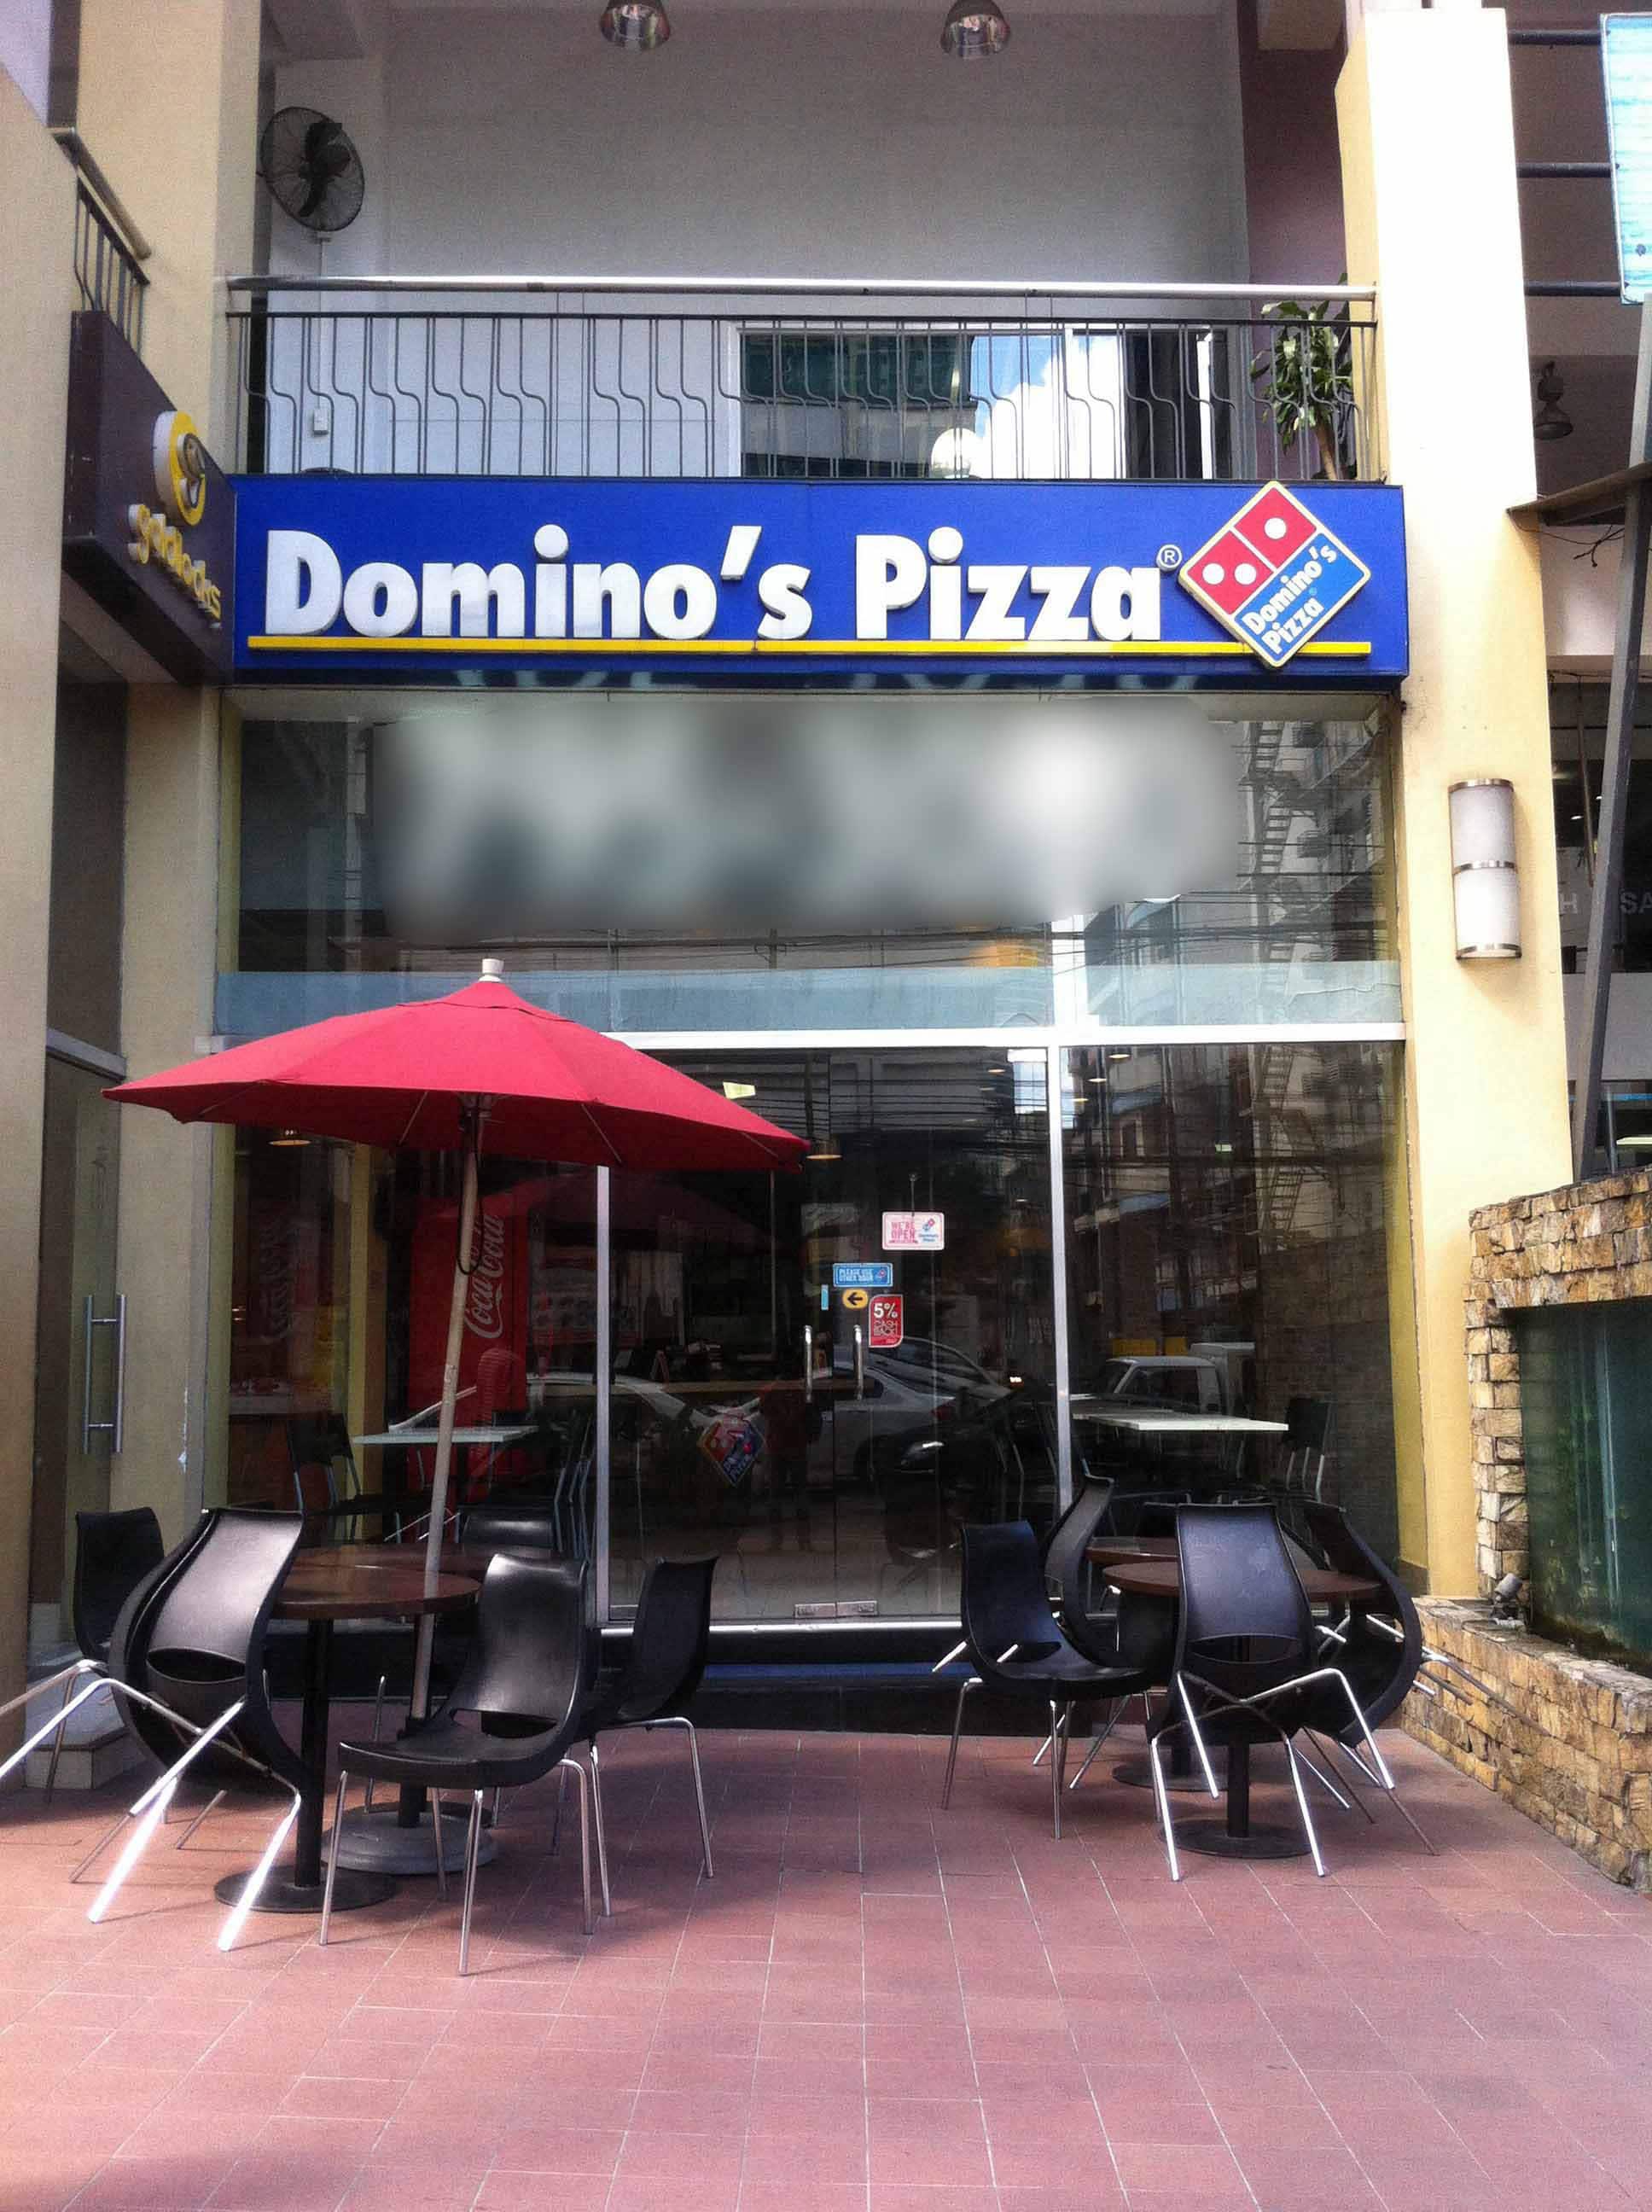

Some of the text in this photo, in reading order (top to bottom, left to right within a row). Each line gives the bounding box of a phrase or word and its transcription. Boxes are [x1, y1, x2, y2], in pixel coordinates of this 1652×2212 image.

[265, 524, 812, 639] Domino's
[856, 526, 1161, 641] Pizza
[1242, 545, 1338, 636] Domino's
[1261, 597, 1325, 655] Pizza
[891, 1230, 916, 1239] OPEN
[874, 1302, 899, 1318] 5%
